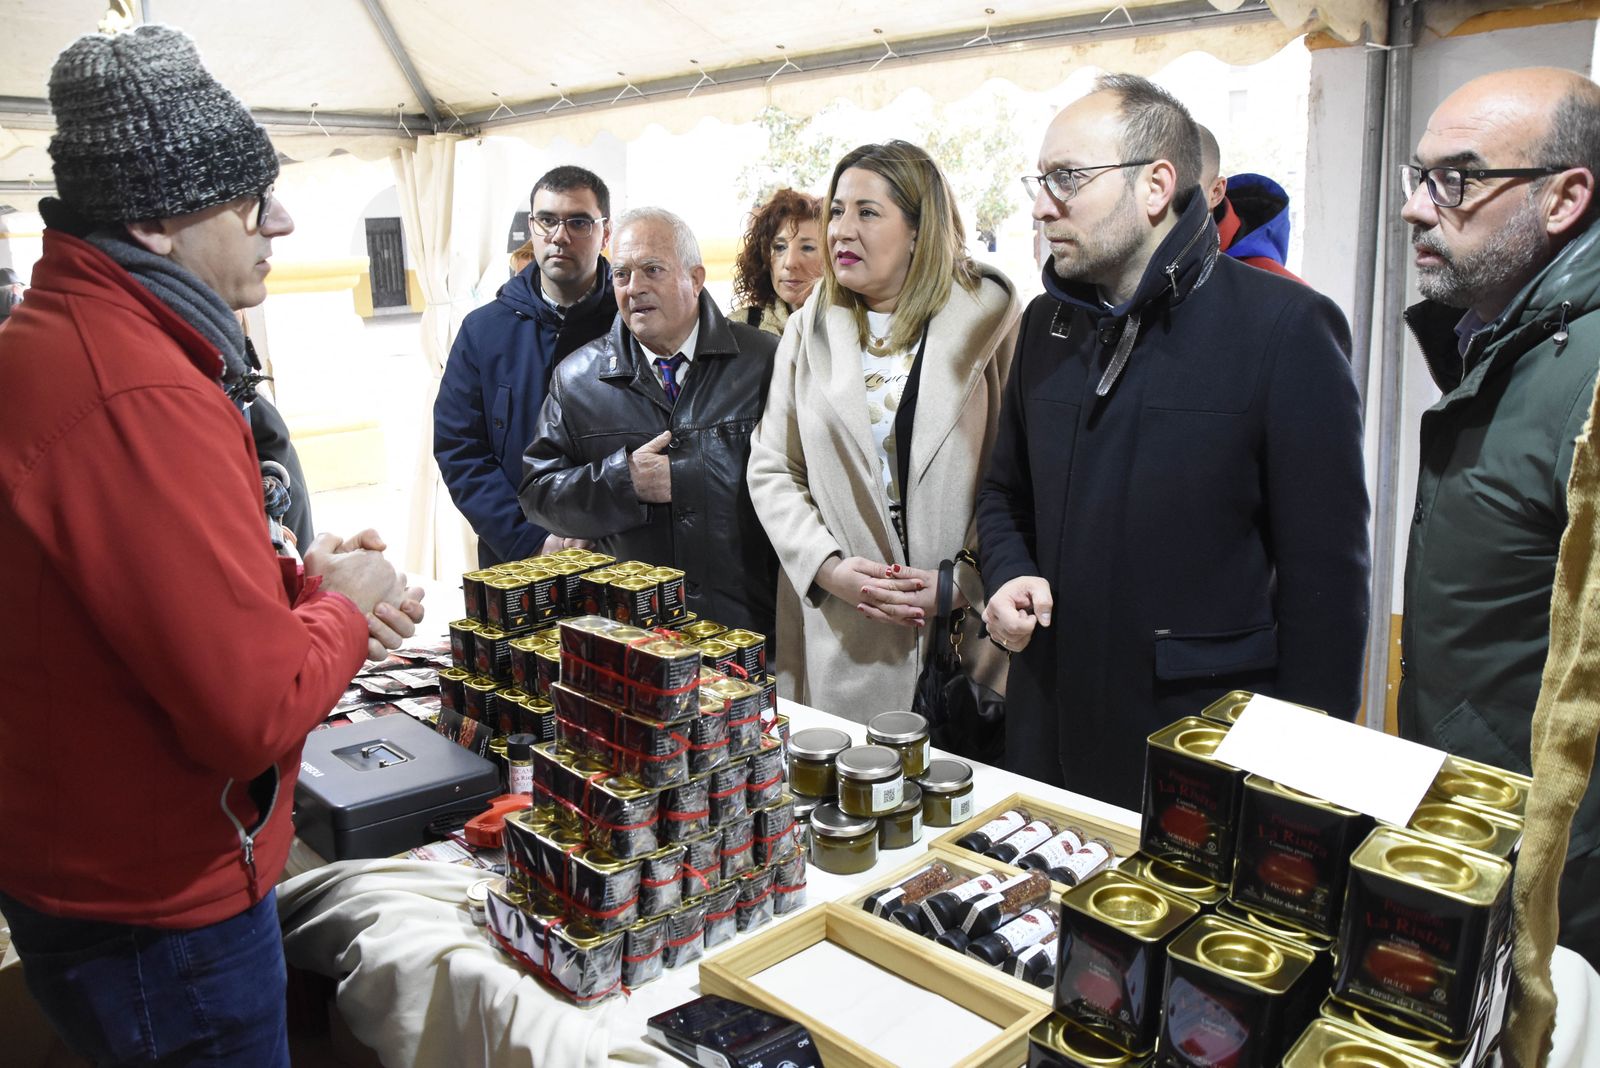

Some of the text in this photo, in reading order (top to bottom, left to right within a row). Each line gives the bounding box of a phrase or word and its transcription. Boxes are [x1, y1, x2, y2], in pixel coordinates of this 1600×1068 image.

[1365, 911, 1389, 928] La
[1396, 917, 1451, 953] Ristra
[1383, 976, 1412, 993] DULCE
